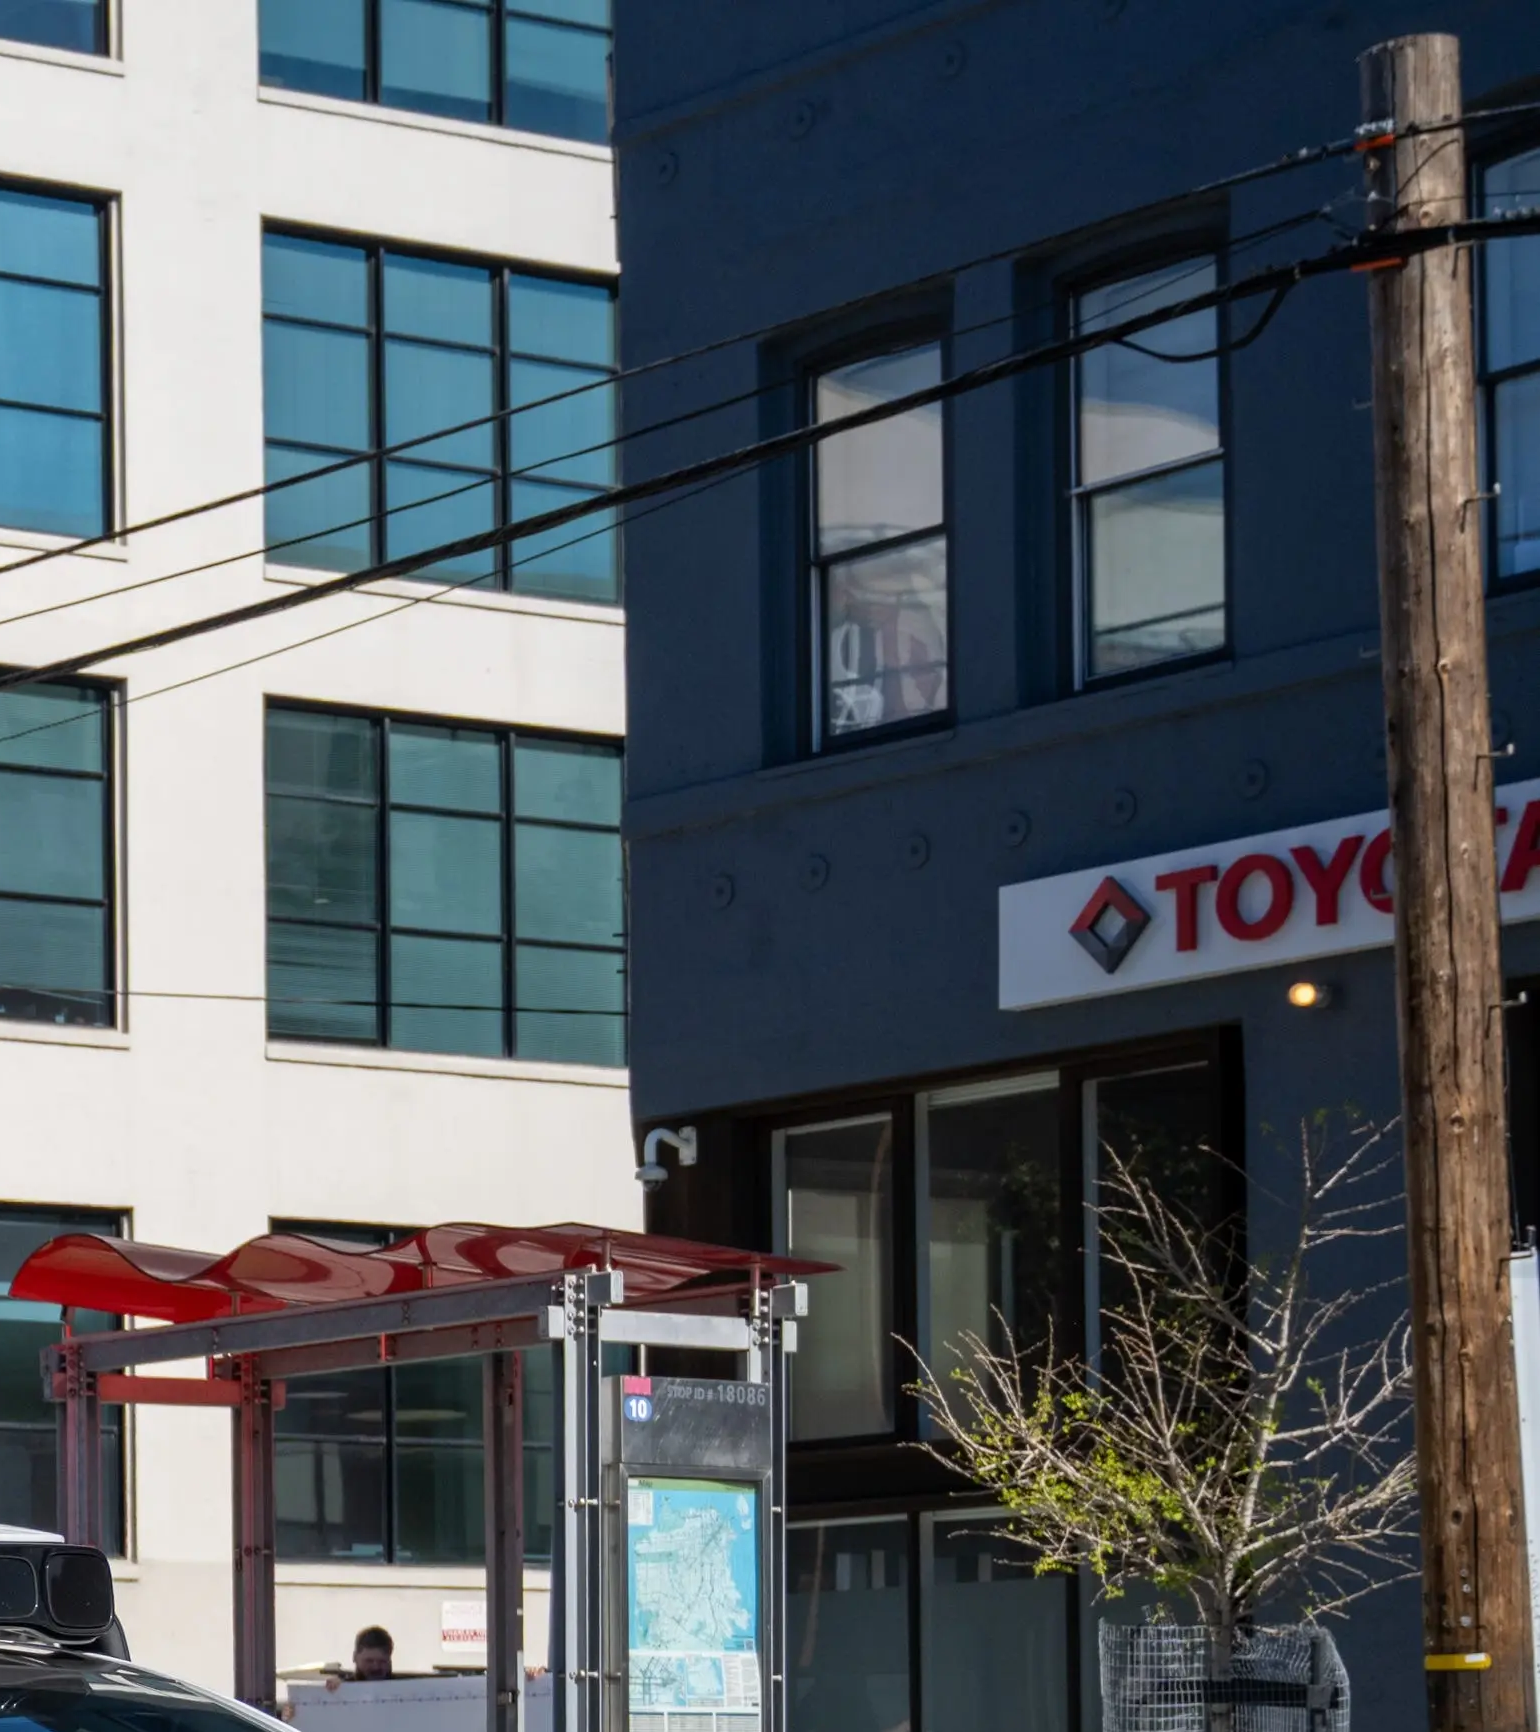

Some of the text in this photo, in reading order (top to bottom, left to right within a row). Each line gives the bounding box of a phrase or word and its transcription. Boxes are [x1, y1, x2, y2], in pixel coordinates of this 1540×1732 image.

[1155, 800, 1540, 952] TOYA
[667, 1384, 692, 1399] STOP
[694, 1387, 705, 1400] ID
[717, 1384, 766, 1406] 18086
[629, 1398, 648, 1418] 10
